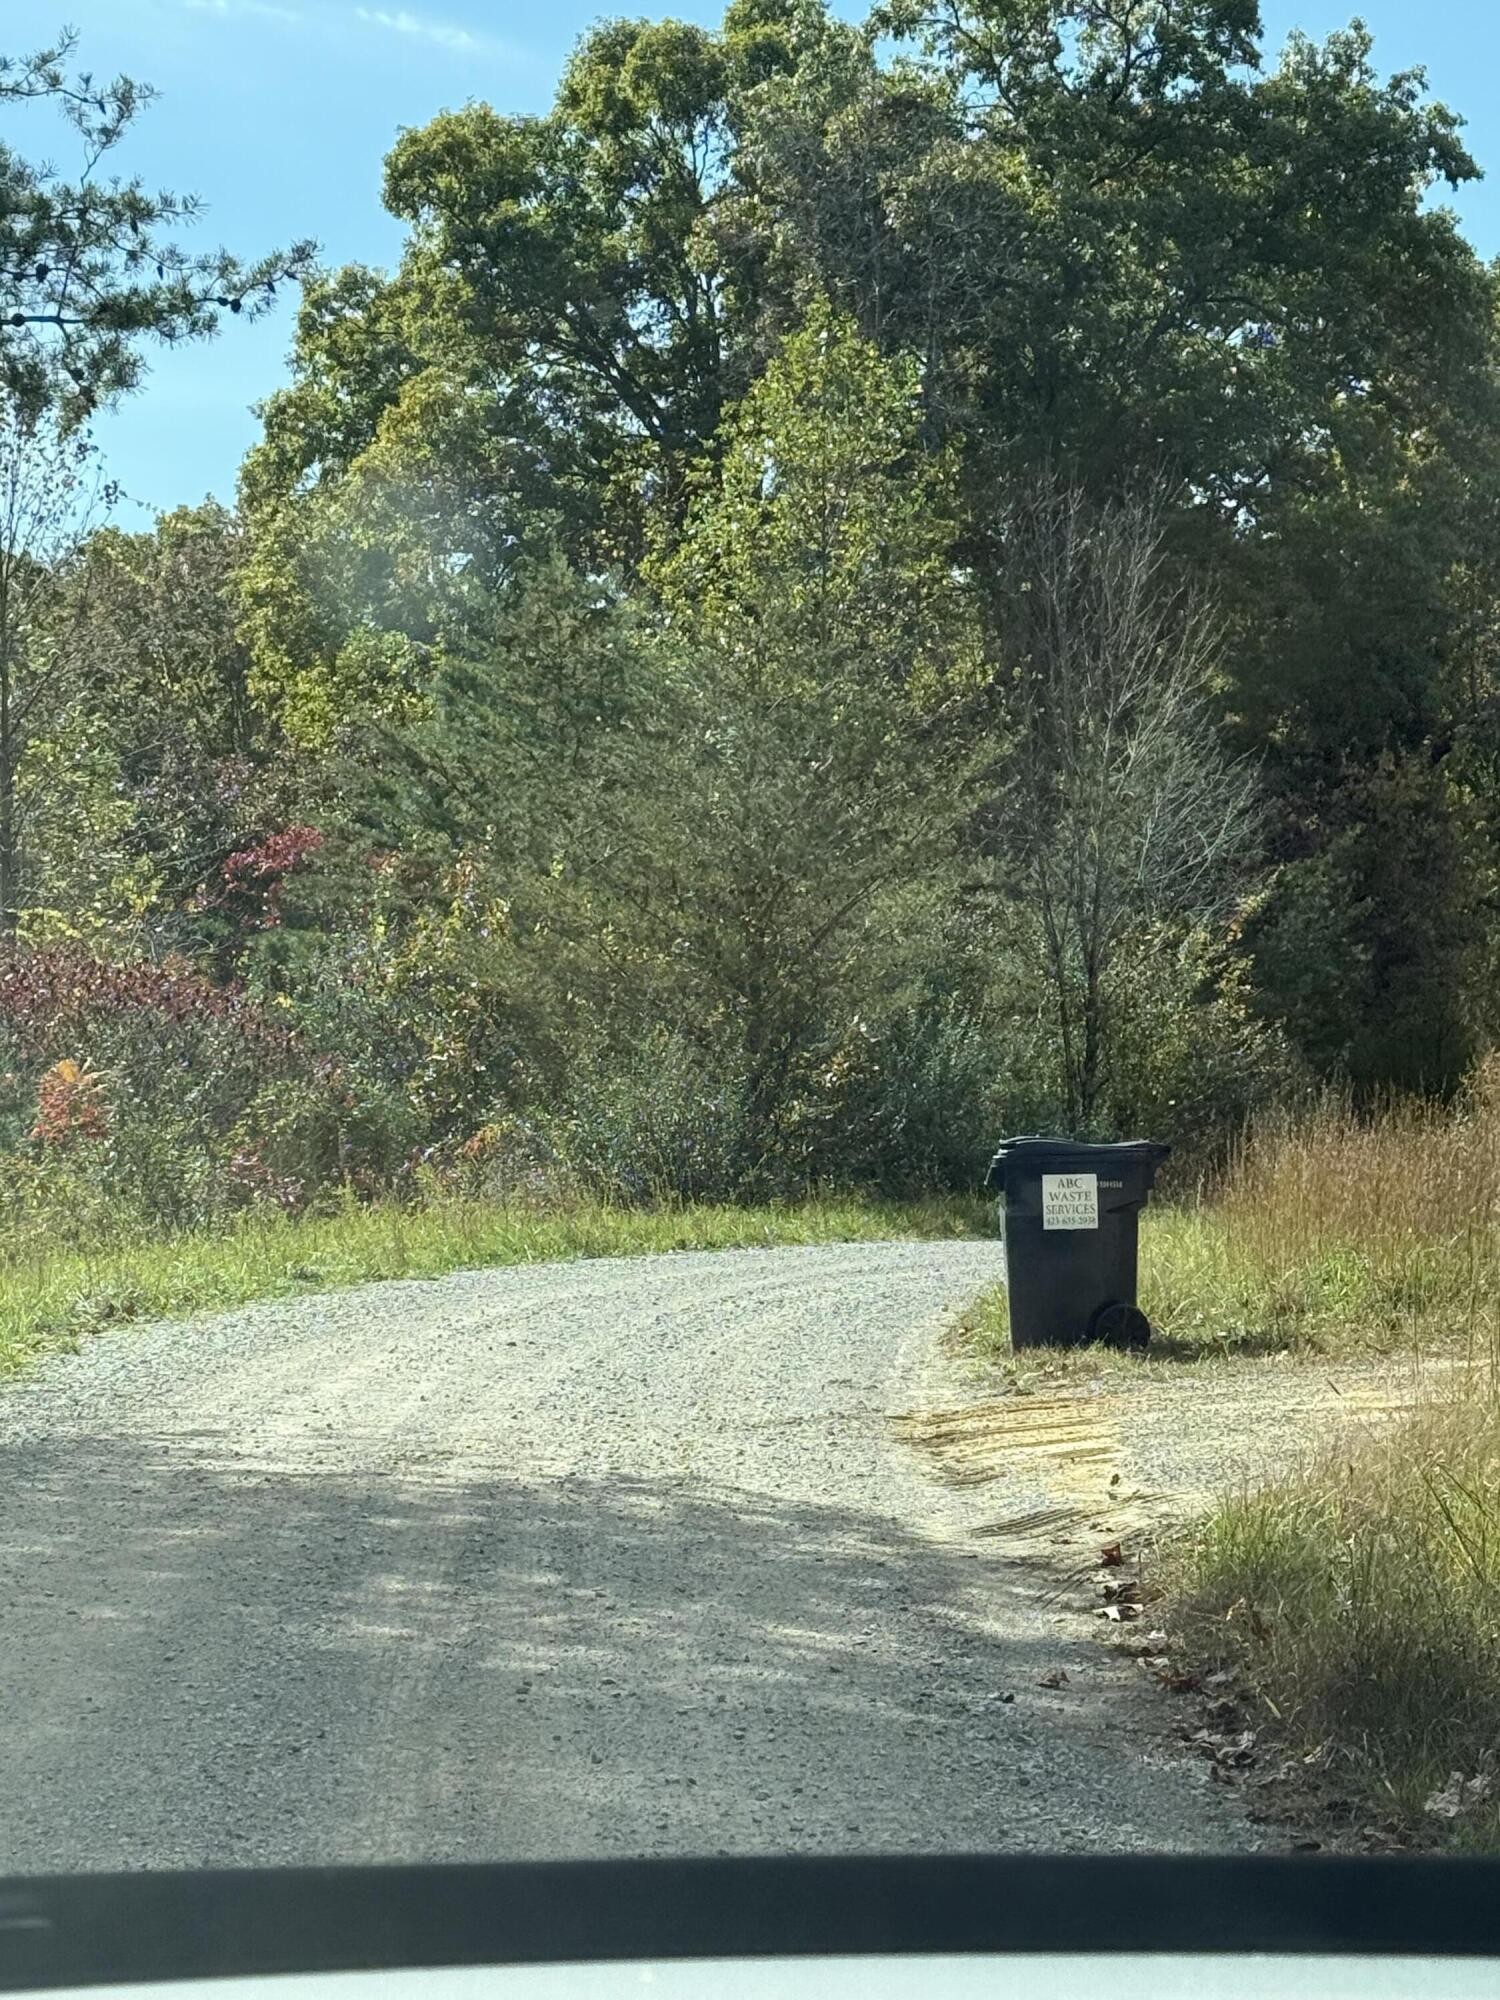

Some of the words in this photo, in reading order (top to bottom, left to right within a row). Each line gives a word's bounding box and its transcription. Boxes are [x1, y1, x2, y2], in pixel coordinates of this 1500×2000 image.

[1057, 1178, 1083, 1189] ABC
[1048, 1191, 1092, 1202] WASTE
[1045, 1203, 1096, 1215] SERVICES
